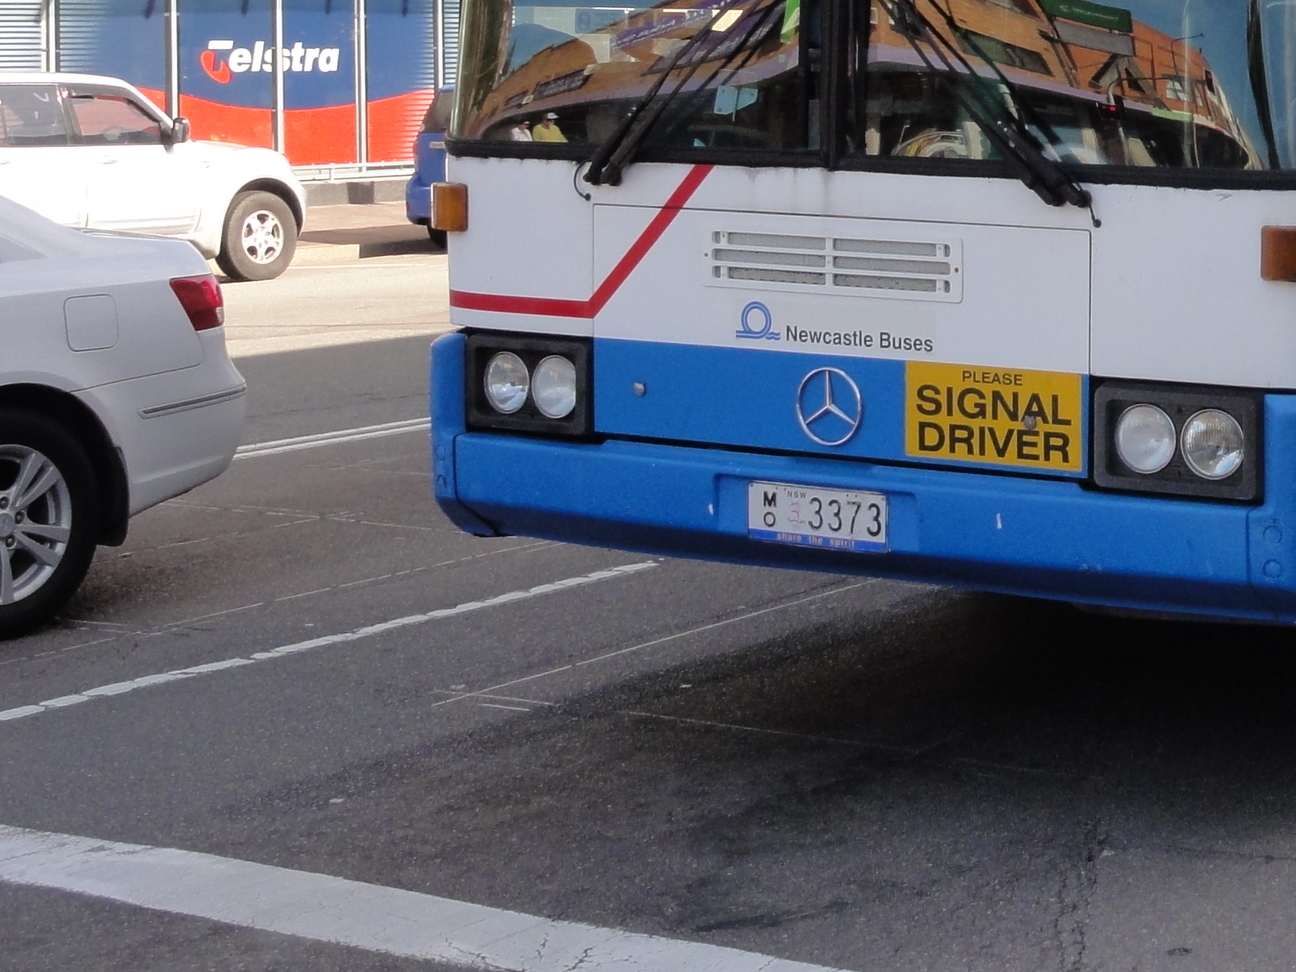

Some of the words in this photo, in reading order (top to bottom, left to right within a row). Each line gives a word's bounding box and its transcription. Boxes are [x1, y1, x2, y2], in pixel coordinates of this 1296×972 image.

[203, 39, 340, 81] Telstra
[785, 325, 874, 348] Newcastle
[879, 331, 934, 353] Buses
[961, 370, 1024, 387] PLEASE
[915, 384, 1072, 427] SIGNAL
[918, 421, 1071, 464] DRIVER
[787, 490, 808, 499] NSW
[808, 497, 882, 537] 3373
